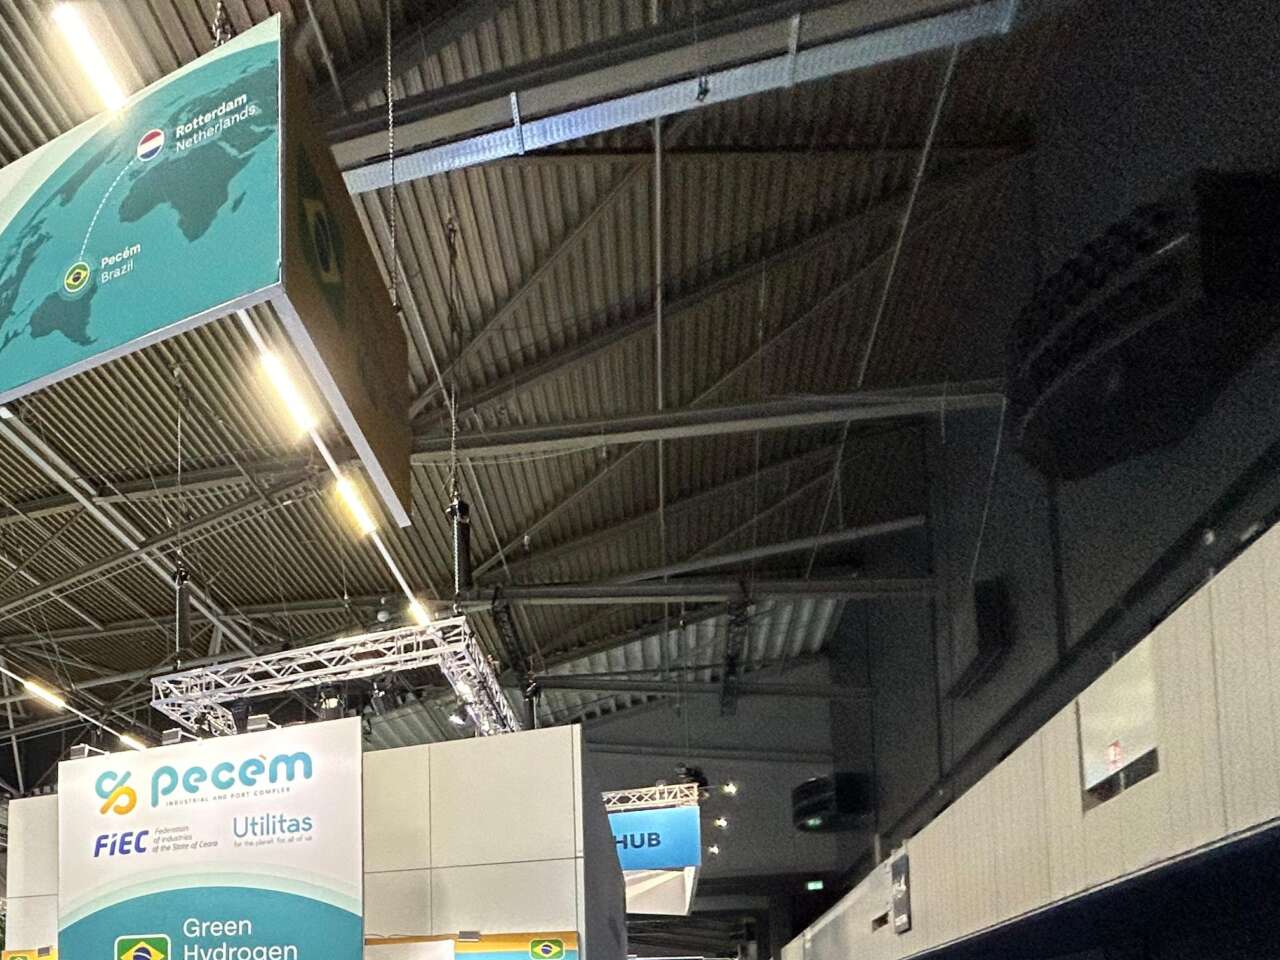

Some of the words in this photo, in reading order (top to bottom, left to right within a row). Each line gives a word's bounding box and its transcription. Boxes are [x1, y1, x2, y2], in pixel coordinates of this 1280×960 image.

[175, 93, 247, 139] Rotterdam
[175, 103, 257, 153] Netherlands
[100, 243, 142, 269] Pecém
[100, 260, 134, 284] Brazil
[166, 797, 209, 807] INDUSTRIAL
[230, 791, 250, 799] PORT
[253, 786, 291, 797] COMPLEX
[233, 812, 313, 838] Utilitas
[613, 832, 661, 850] HUB
[183, 918, 252, 938] Green
